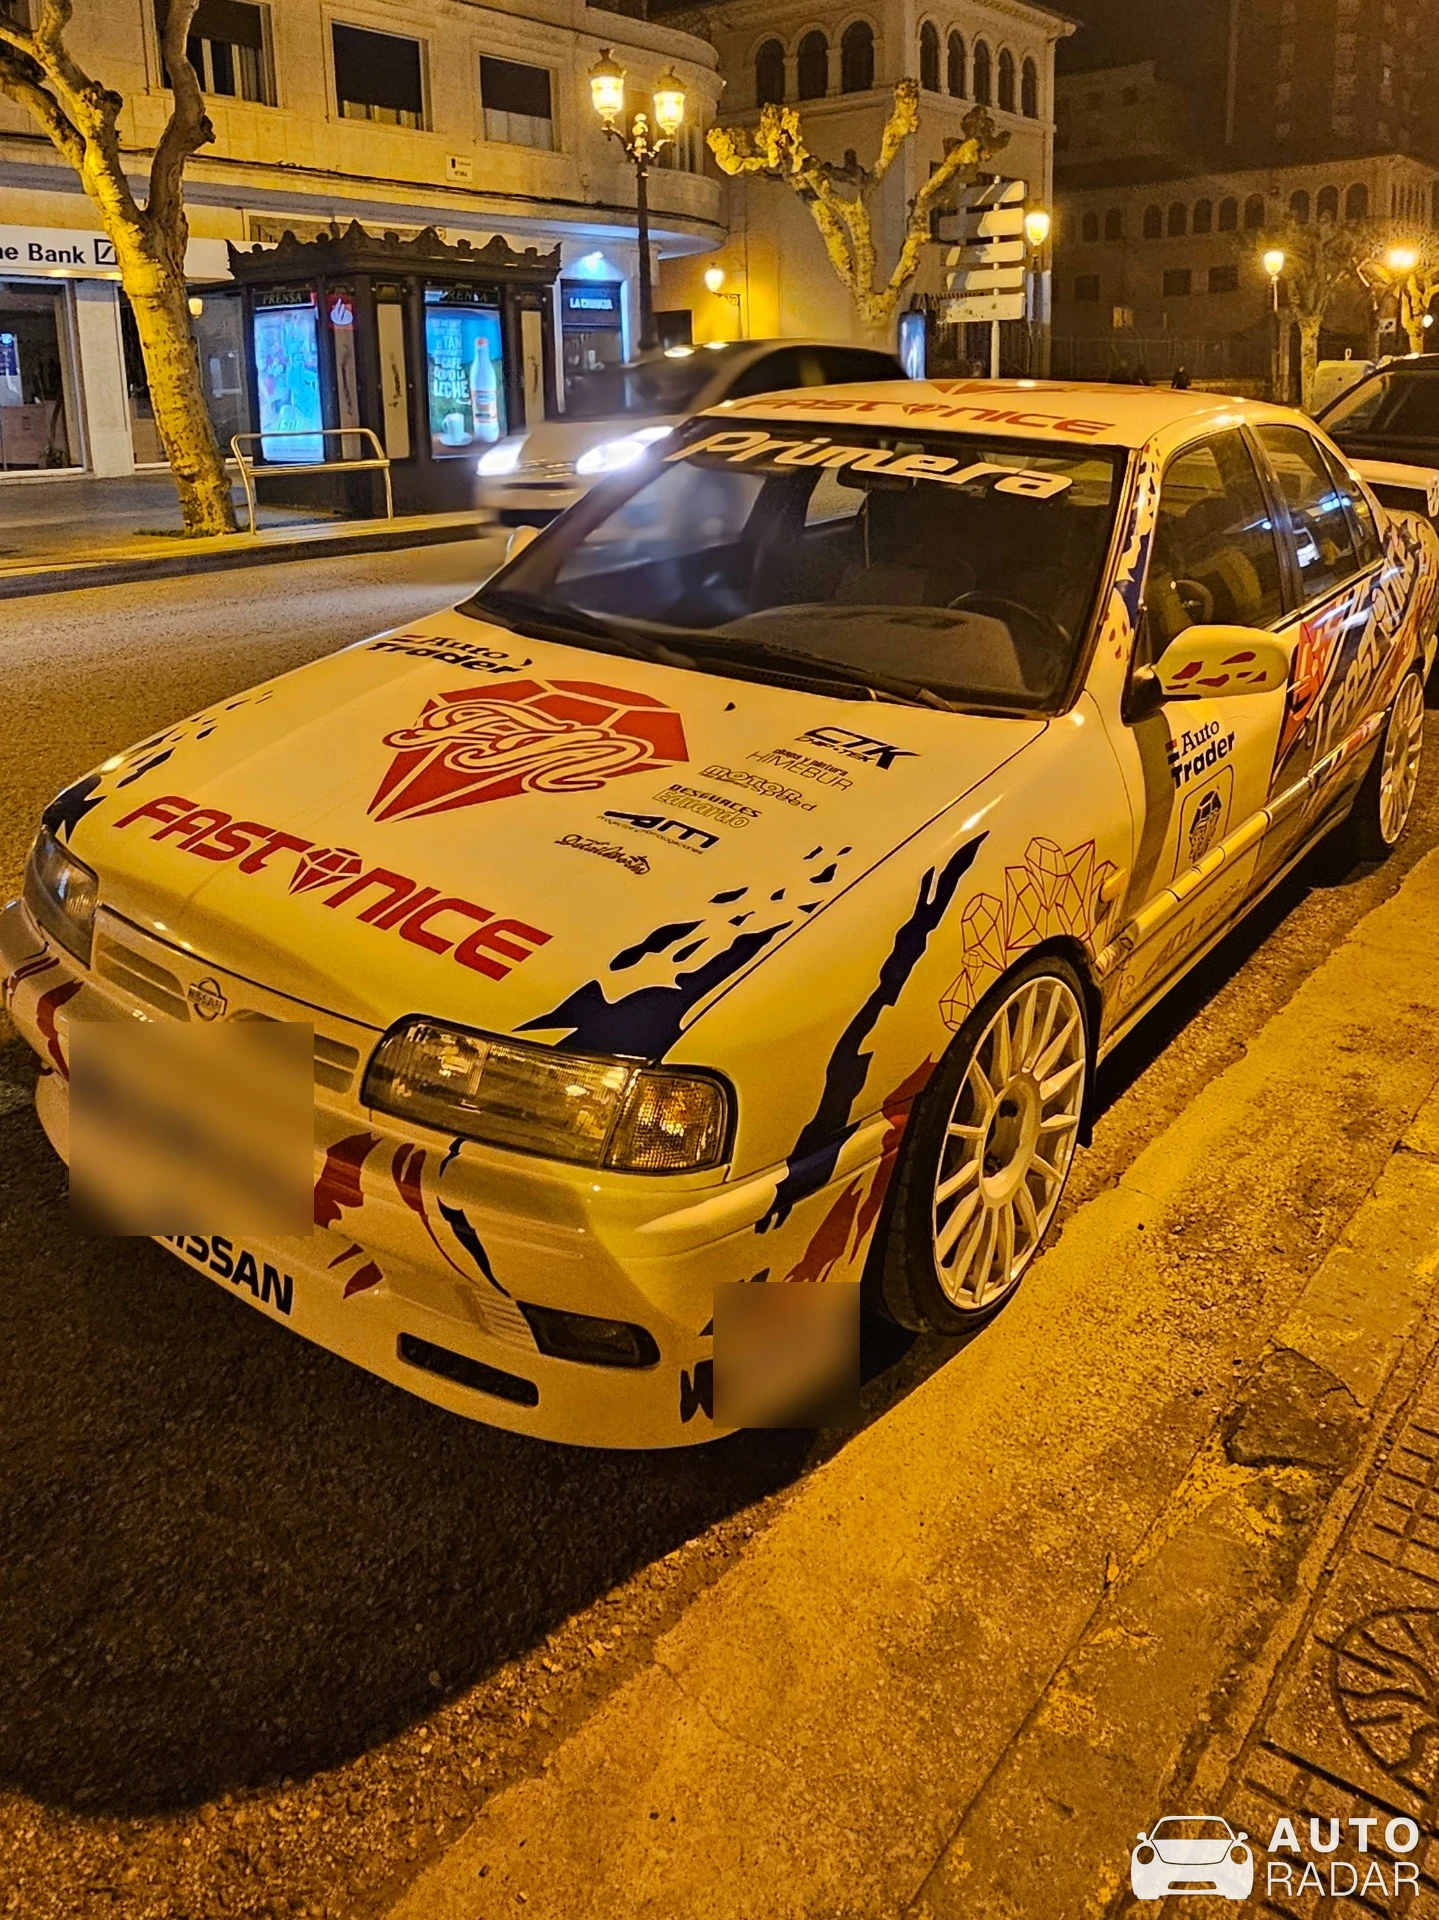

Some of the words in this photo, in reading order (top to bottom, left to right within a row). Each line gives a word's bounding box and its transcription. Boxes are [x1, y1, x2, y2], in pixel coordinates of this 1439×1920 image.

[0, 246, 19, 260] e
[28, 243, 86, 264] Bank
[262, 292, 302, 304] PRENSA
[433, 379, 470, 399] LECHE
[944, 406, 1116, 437] NICE
[663, 431, 1074, 499] Primera
[367, 642, 524, 674] Trader
[418, 636, 510, 660] Auto
[803, 726, 922, 771] CTK
[1181, 720, 1220, 757] Auto
[745, 750, 854, 792] HIMEBUR
[808, 759, 850, 777] pintura
[1171, 731, 1236, 790] Trader
[652, 789, 750, 829] Eduardo
[668, 783, 763, 818] DESGUACES
[111, 795, 317, 875] FAST
[321, 866, 554, 982] NICE
[163, 1236, 294, 1317] SSAN
